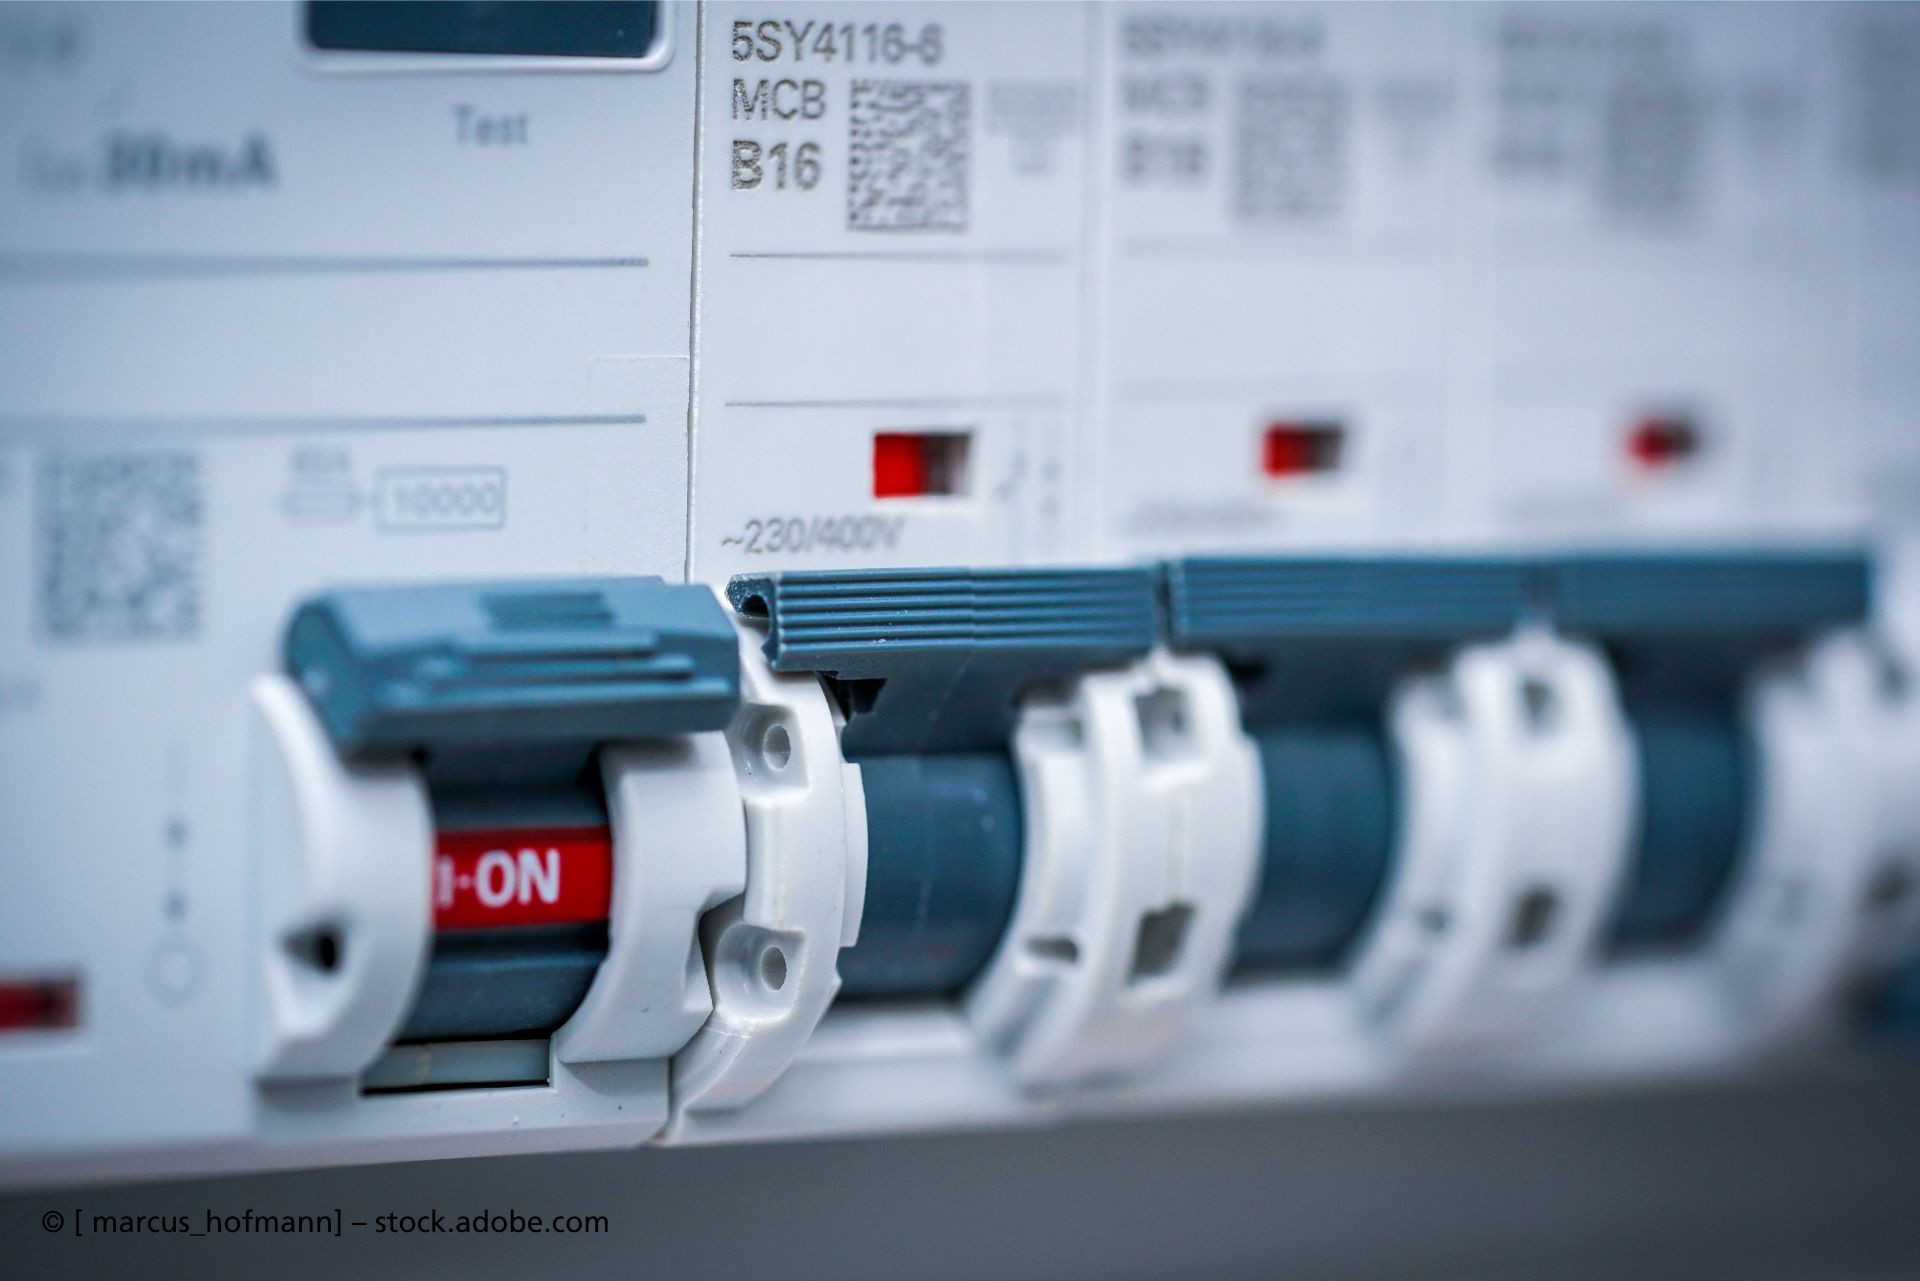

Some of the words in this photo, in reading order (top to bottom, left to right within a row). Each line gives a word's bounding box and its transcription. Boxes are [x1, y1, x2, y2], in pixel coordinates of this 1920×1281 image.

[731, 20, 945, 66] 5SY4116-6
[731, 77, 827, 121] MCB
[455, 104, 529, 146] Test
[731, 139, 822, 191] B16
